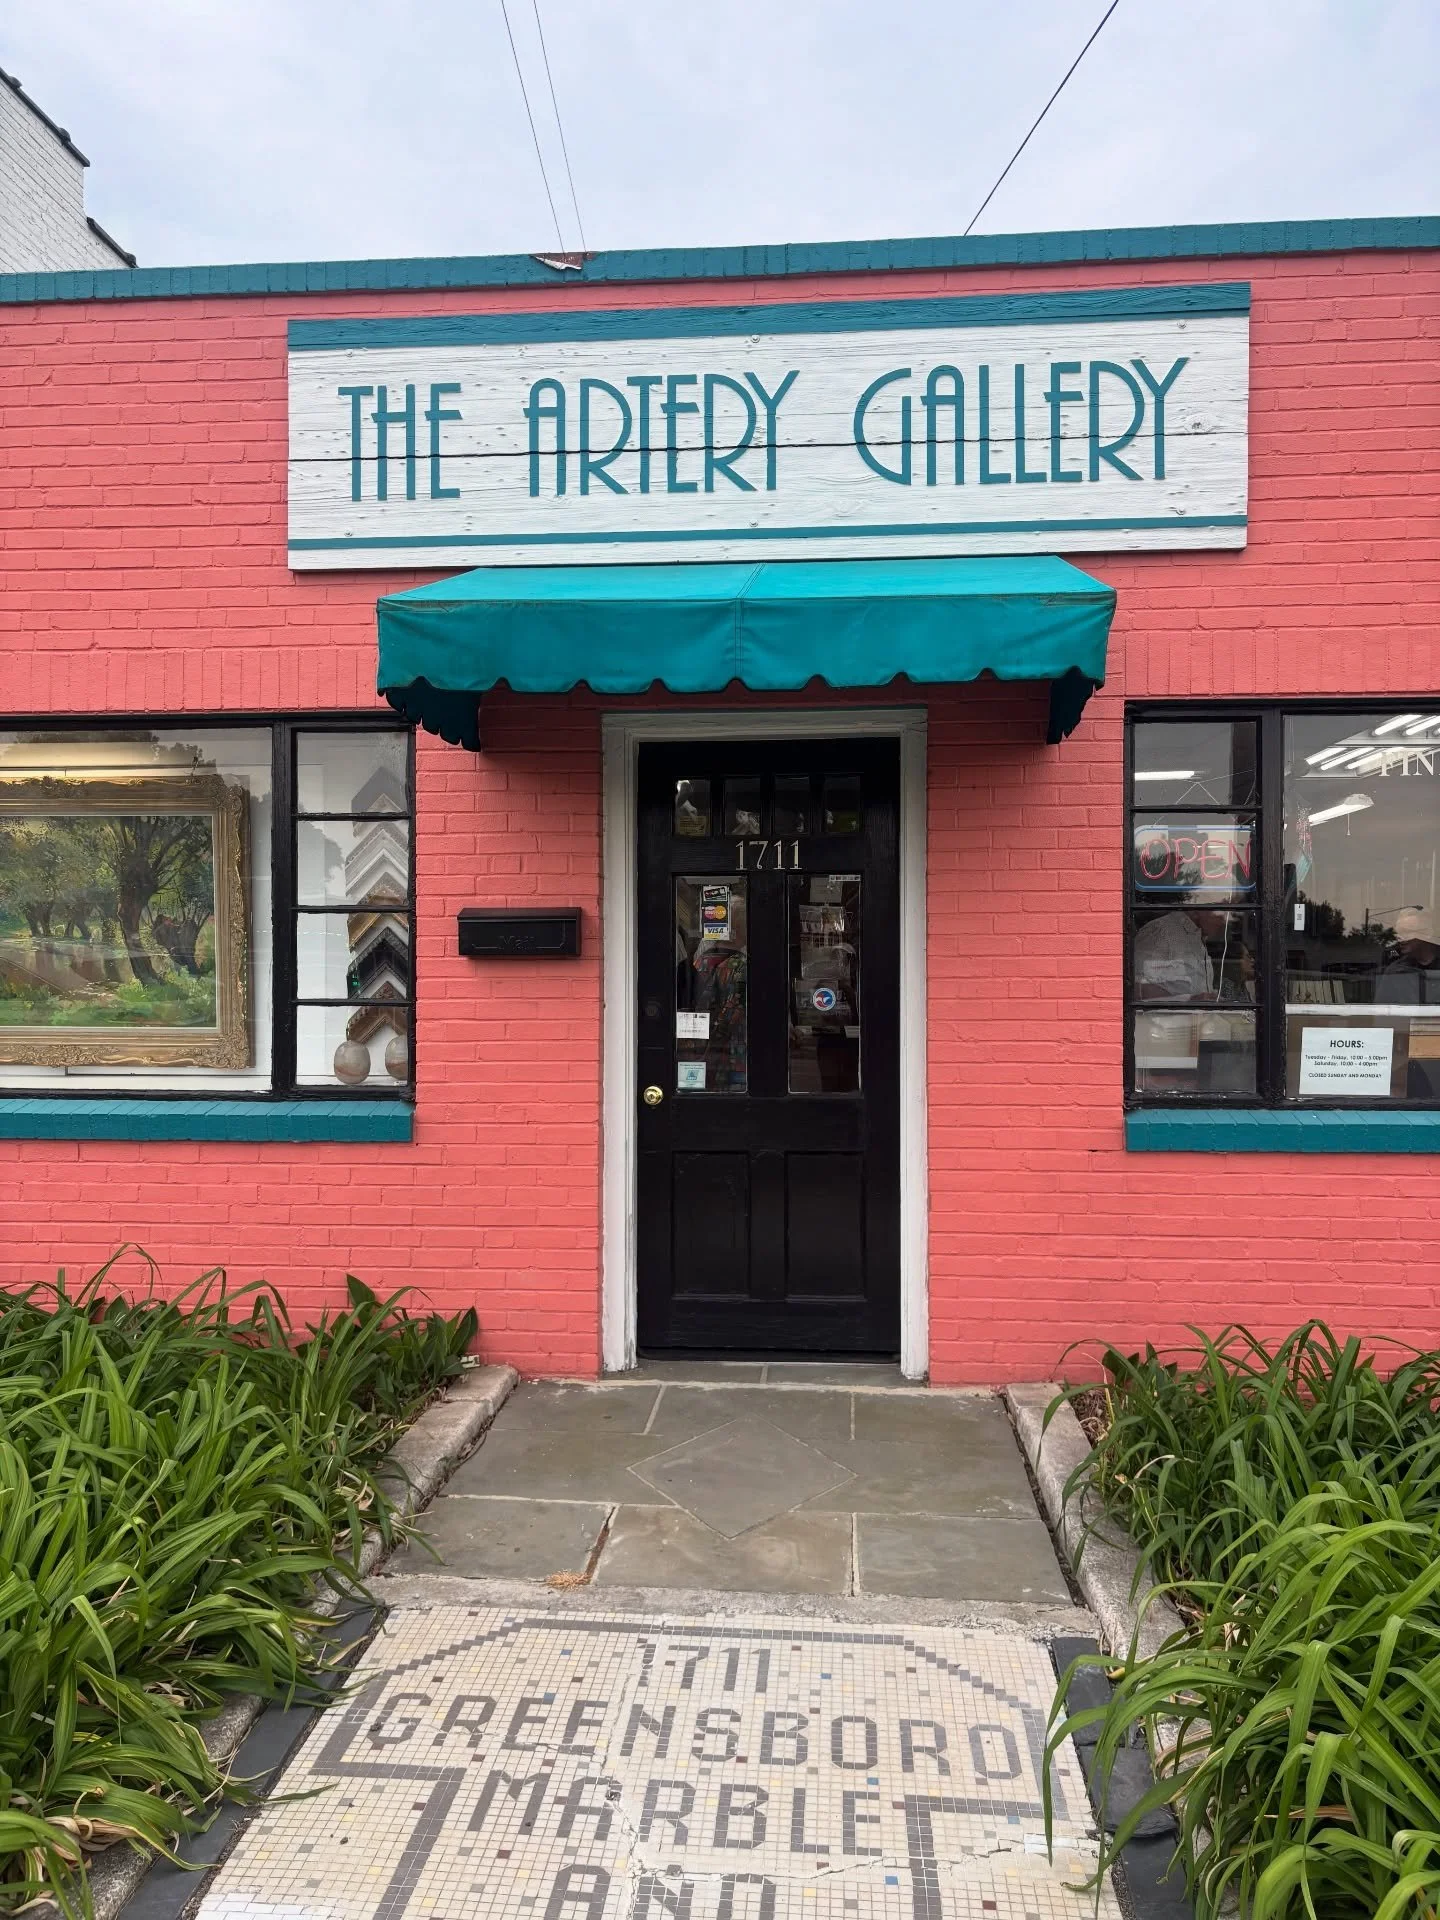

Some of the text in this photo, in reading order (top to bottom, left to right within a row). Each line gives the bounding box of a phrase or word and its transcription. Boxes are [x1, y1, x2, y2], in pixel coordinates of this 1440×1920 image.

[338, 357, 1190, 502] THE ARTERY GALLERY
[735, 840, 803, 870] 1711
[1140, 837, 1252, 880] OPEN
[1330, 1040, 1364, 1048] HOURS:
[638, 1638, 771, 1693] 1711
[366, 1692, 1023, 1780] GREENSBORO
[466, 1769, 883, 1857] MARBLE
